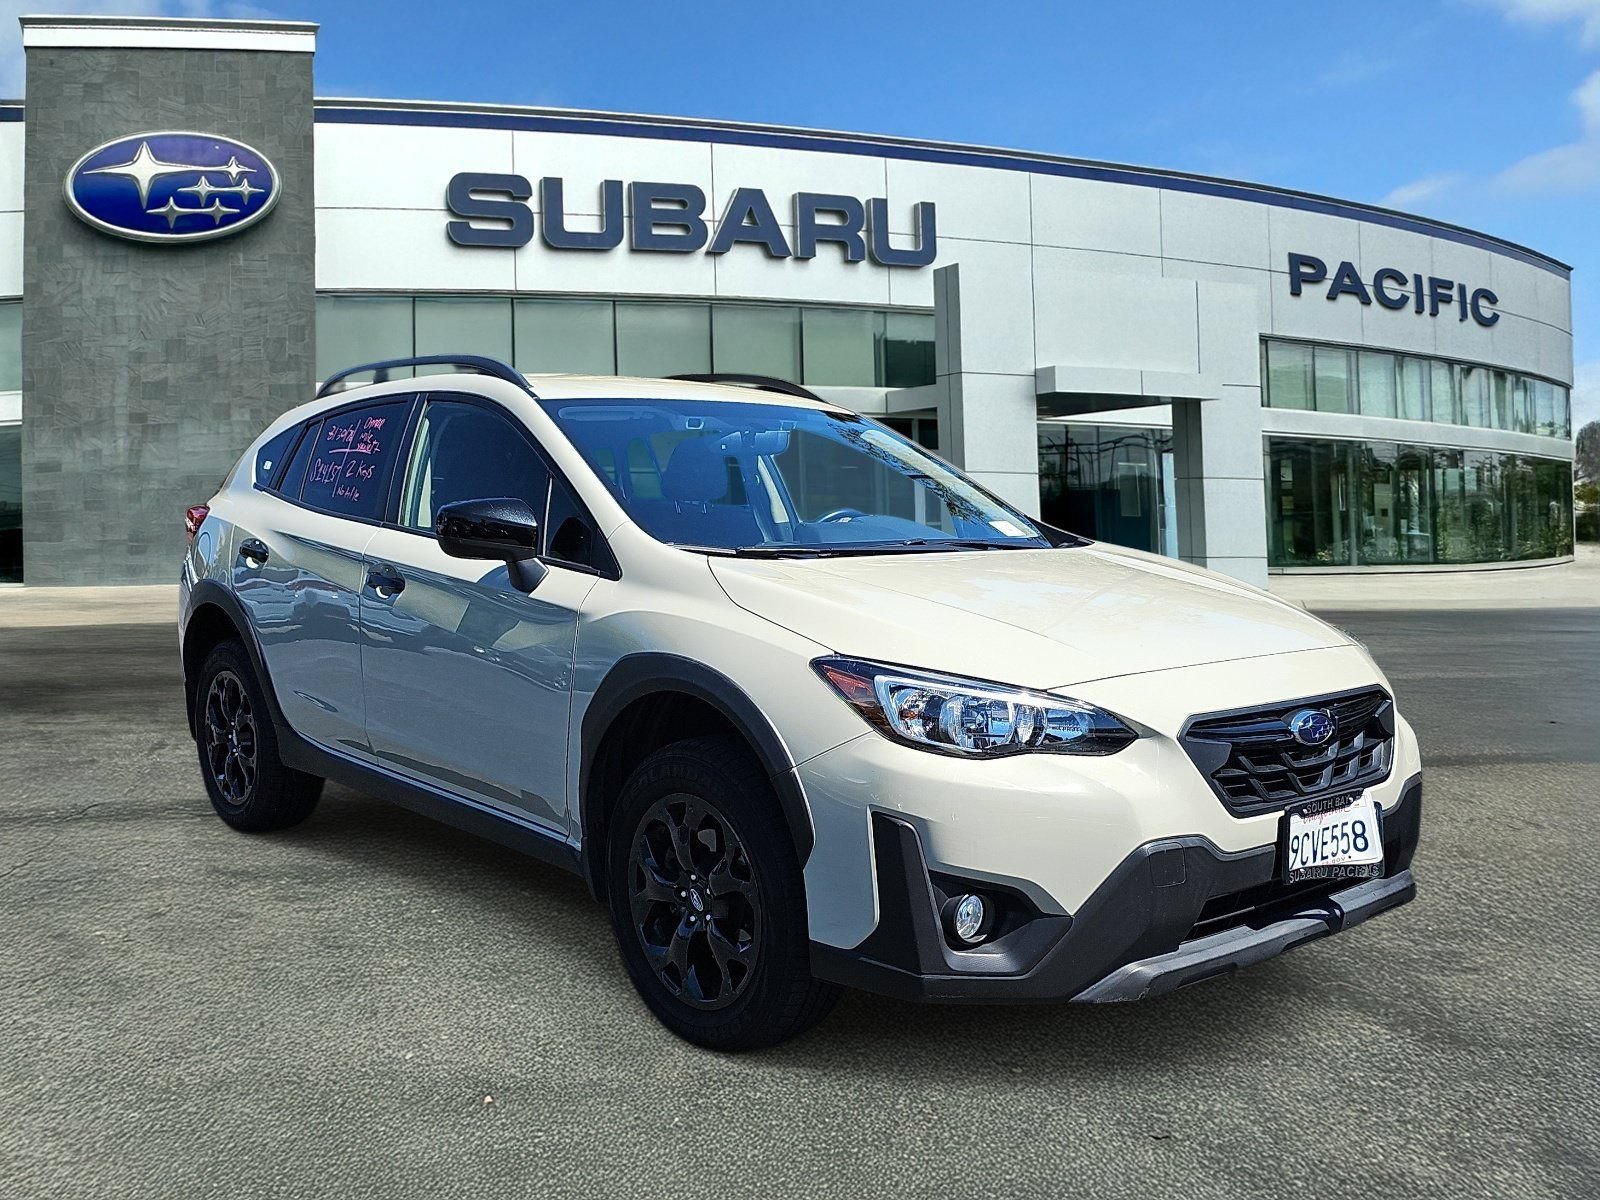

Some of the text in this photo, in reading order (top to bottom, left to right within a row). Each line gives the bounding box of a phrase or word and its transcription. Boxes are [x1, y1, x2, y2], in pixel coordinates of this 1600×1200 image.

[447, 172, 938, 268] SUBARU
[1288, 252, 1500, 327] PACIFIC
[346, 460, 357, 477] 2
[1306, 795, 1351, 814] SOUTH BAY
[1290, 819, 1369, 871] 9CVE558
[1289, 867, 1328, 884] SUBARU
